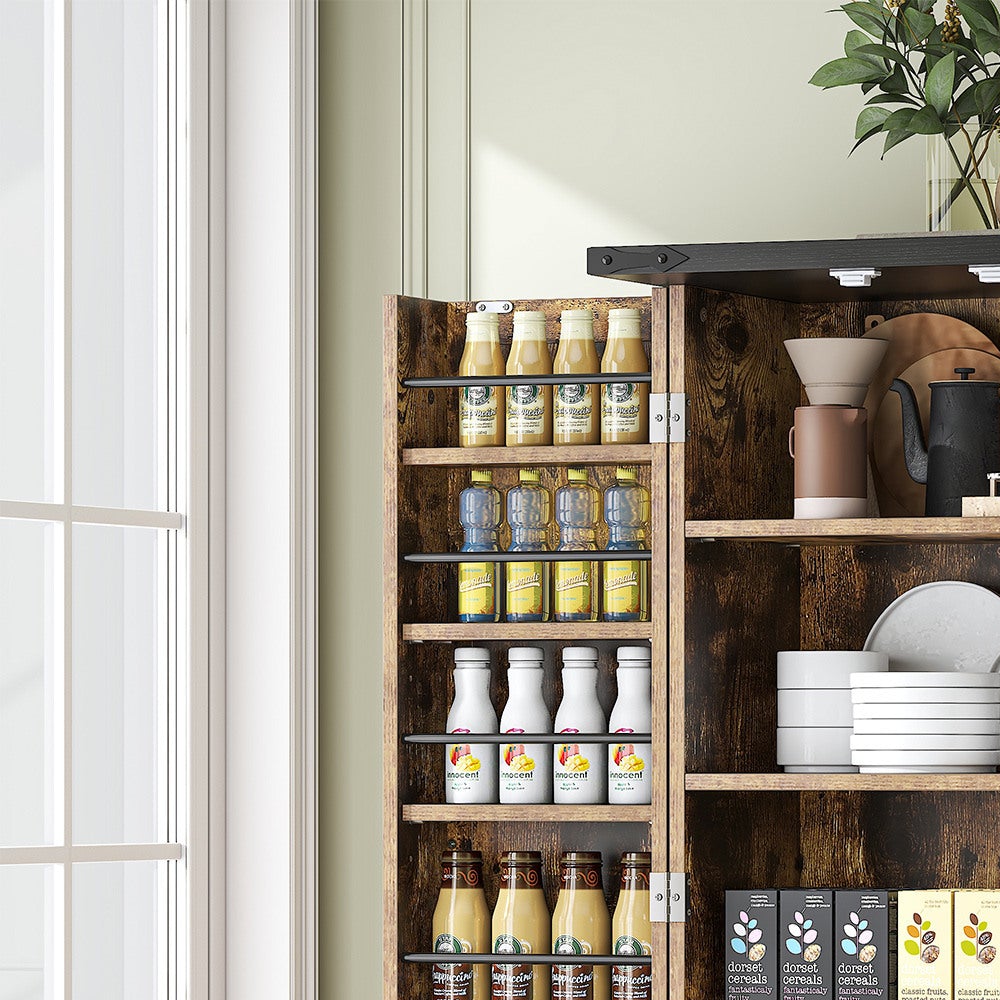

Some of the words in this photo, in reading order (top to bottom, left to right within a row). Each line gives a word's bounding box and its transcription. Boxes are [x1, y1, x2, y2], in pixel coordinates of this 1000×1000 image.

[728, 962, 763, 972] dorset
[783, 962, 818, 973] dorset
[838, 963, 874, 974] dorset
[728, 974, 768, 984] cereals
[783, 974, 822, 984] cereals
[838, 975, 878, 986] cereals
